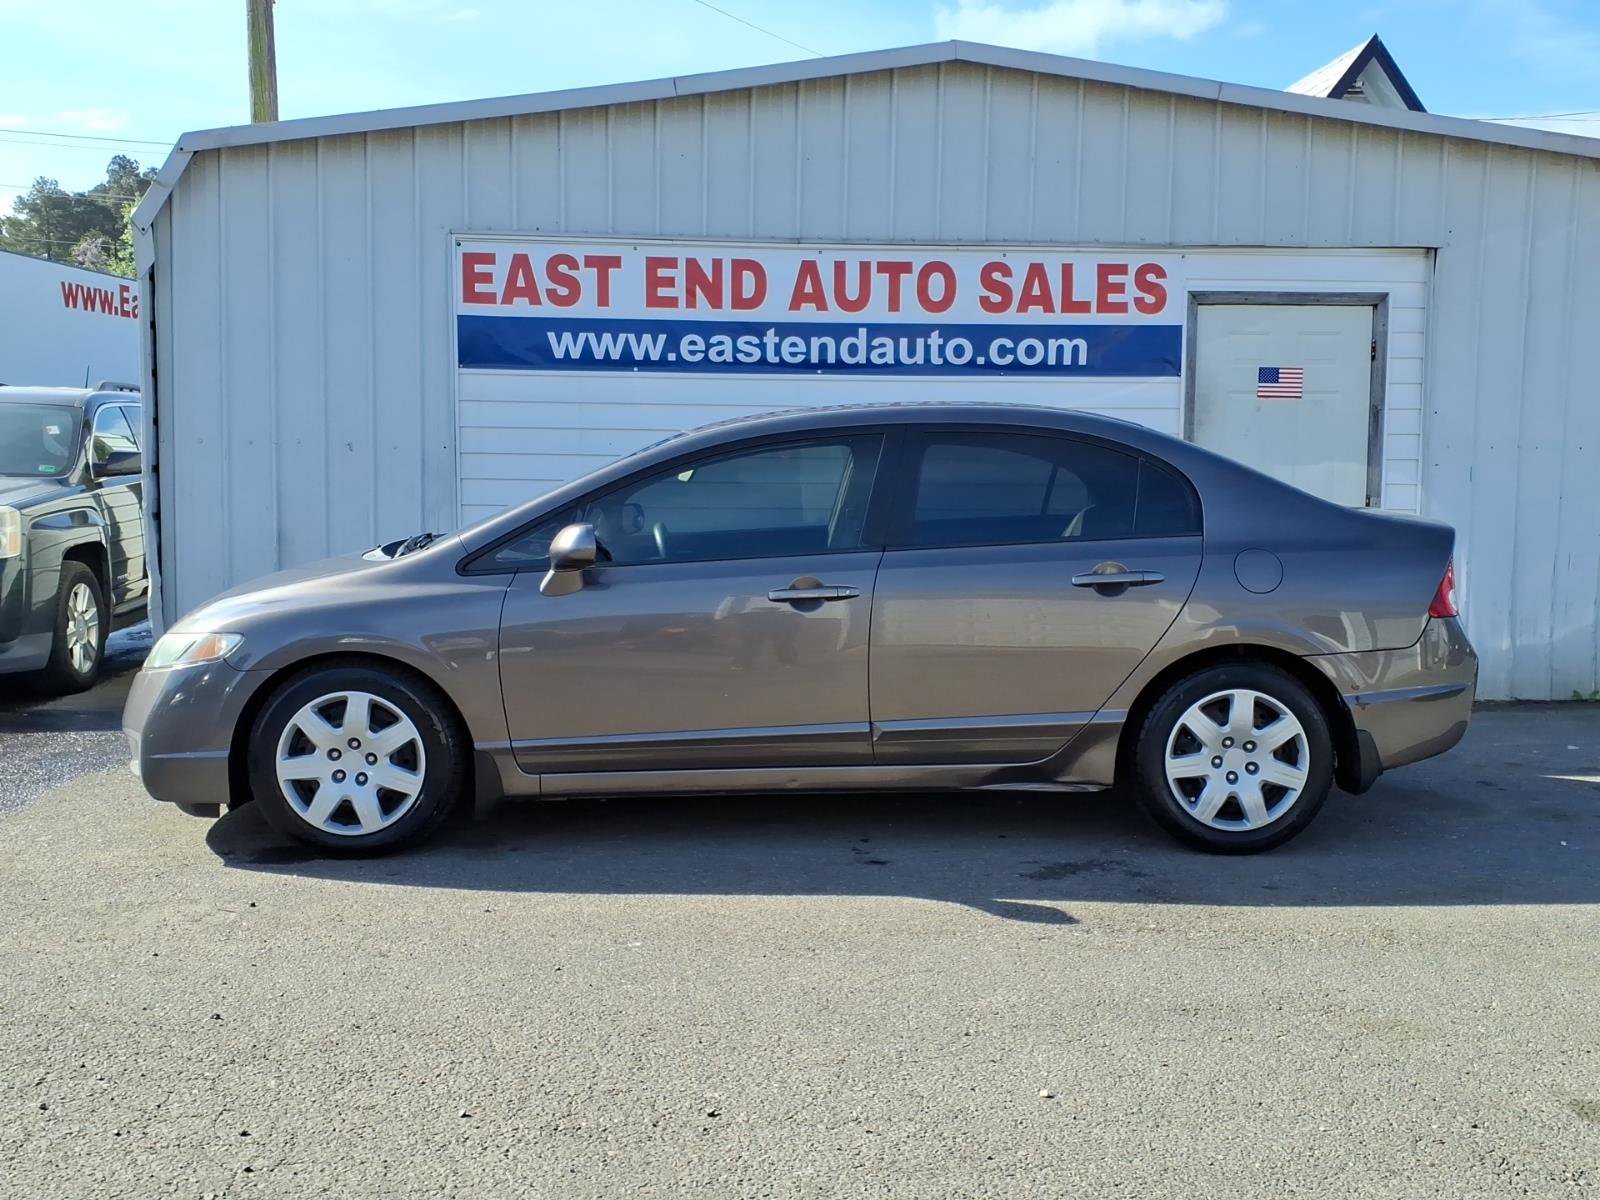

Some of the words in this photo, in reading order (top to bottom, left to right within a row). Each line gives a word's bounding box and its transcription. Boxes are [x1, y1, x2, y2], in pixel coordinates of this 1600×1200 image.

[461, 252, 622, 308] EAST
[644, 256, 768, 311] END
[788, 260, 957, 314] AUTO
[979, 261, 1168, 315] SALES
[547, 327, 1088, 366] www.eastendauto.com
